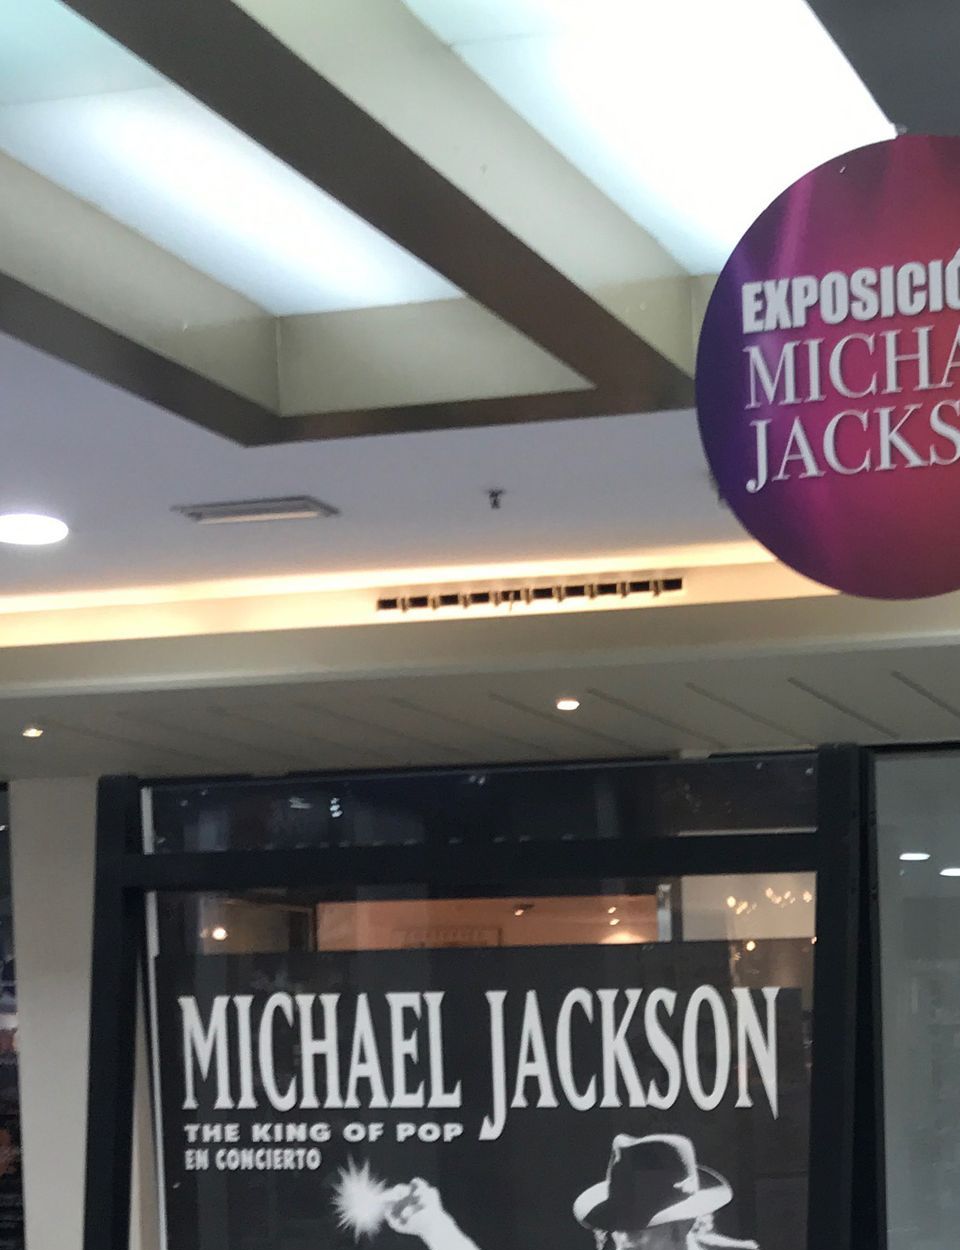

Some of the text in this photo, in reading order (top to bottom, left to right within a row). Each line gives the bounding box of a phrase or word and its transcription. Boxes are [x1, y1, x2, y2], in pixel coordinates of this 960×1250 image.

[178, 983, 781, 1141] MICHAEL JACKSON
[184, 1121, 464, 1143] THE KING OF POP
[184, 1147, 322, 1171] EN CONCIERTO
